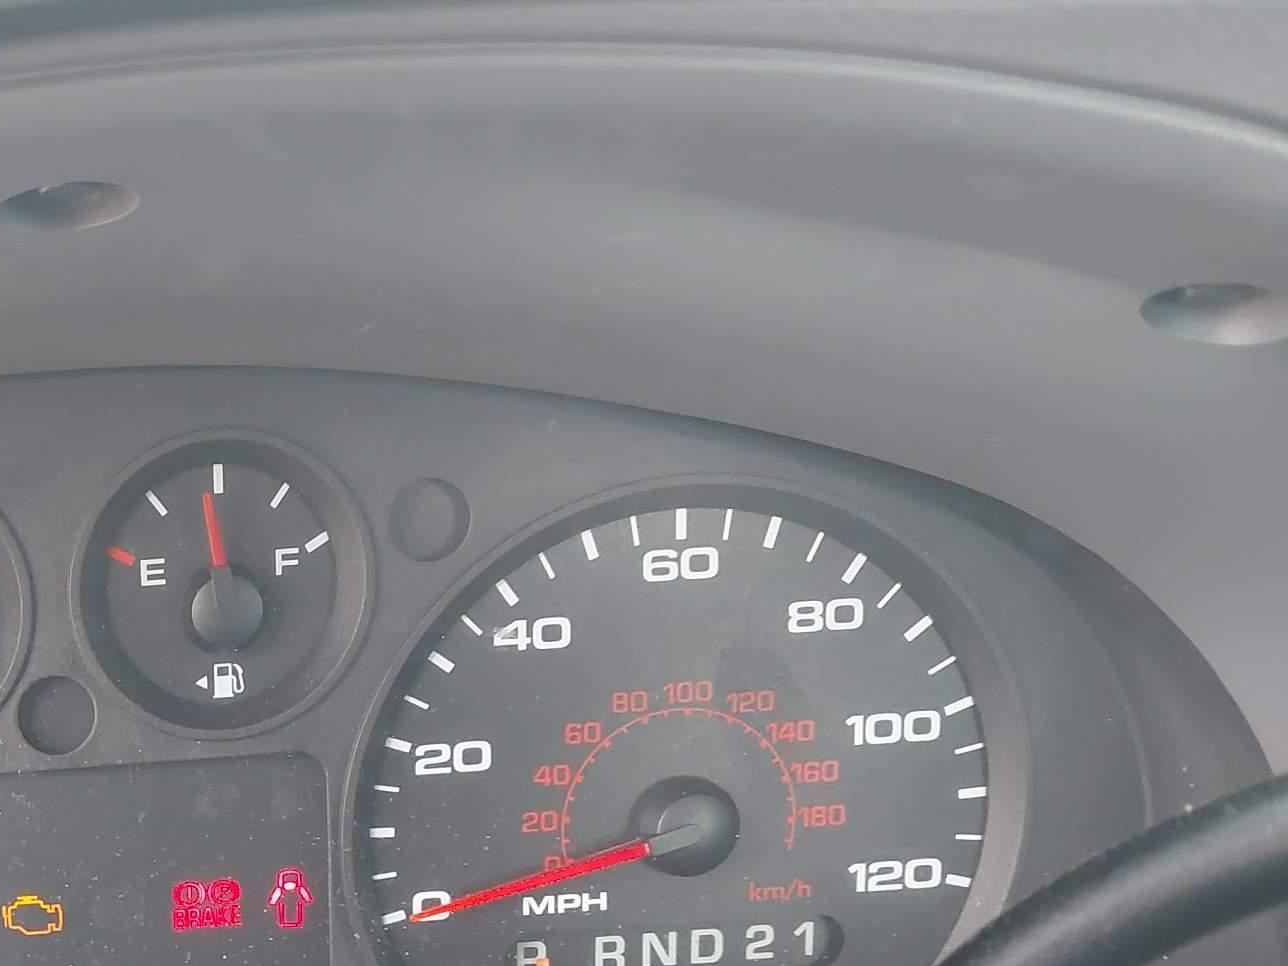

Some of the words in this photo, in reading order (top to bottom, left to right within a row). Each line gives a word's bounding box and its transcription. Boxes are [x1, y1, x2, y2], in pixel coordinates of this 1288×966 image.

[140, 558, 167, 587] E
[275, 547, 300, 576] F
[643, 547, 719, 582] 60
[787, 598, 864, 634] 80
[493, 616, 572, 651] 40
[611, 690, 649, 712] 80
[663, 680, 713, 703] 100
[727, 690, 775, 713] 120
[564, 722, 602, 745] 60
[767, 720, 815, 743] 140
[845, 710, 941, 746] 100
[415, 740, 492, 776] 20
[533, 764, 572, 786] 40
[793, 761, 839, 784] 160
[522, 811, 558, 833] 20
[799, 805, 847, 827] 180
[847, 858, 942, 893] 120
[748, 880, 811, 902] km/h
[411, 890, 451, 922] 0
[522, 891, 608, 916] MPH
[173, 906, 243, 930] BRAKE
[690, 928, 724, 964] D
[745, 924, 775, 960] 2
[793, 921, 815, 956] 1
